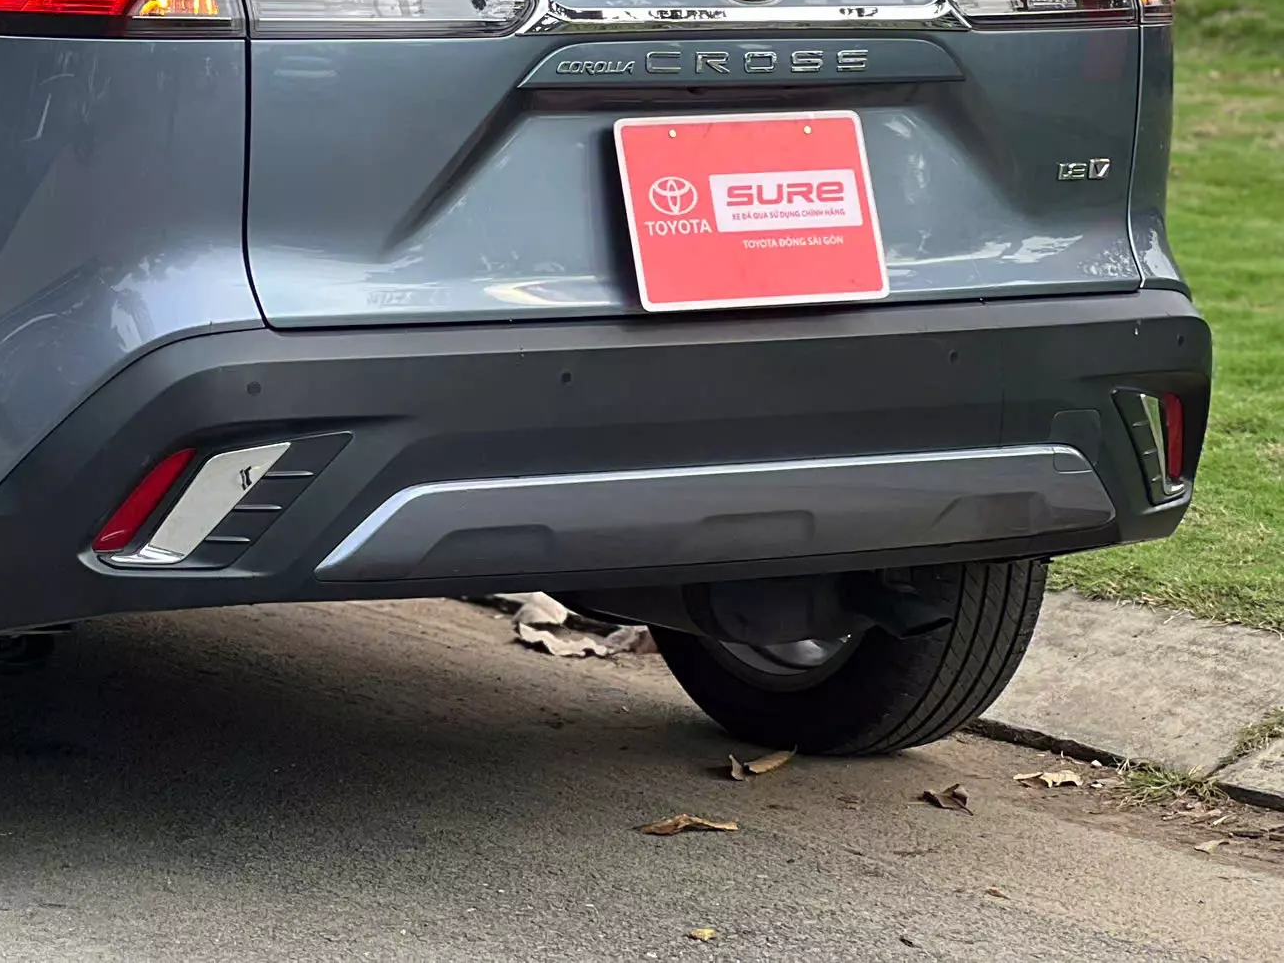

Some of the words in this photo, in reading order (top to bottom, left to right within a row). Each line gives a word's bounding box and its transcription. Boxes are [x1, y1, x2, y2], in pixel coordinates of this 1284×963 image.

[556, 60, 636, 75] COROLLA
[645, 49, 869, 75] CROSS
[732, 213, 741, 221] XE
[753, 212, 769, 220] QUA
[644, 219, 713, 237] TOYOTA
[743, 238, 778, 249] TOYOTA
